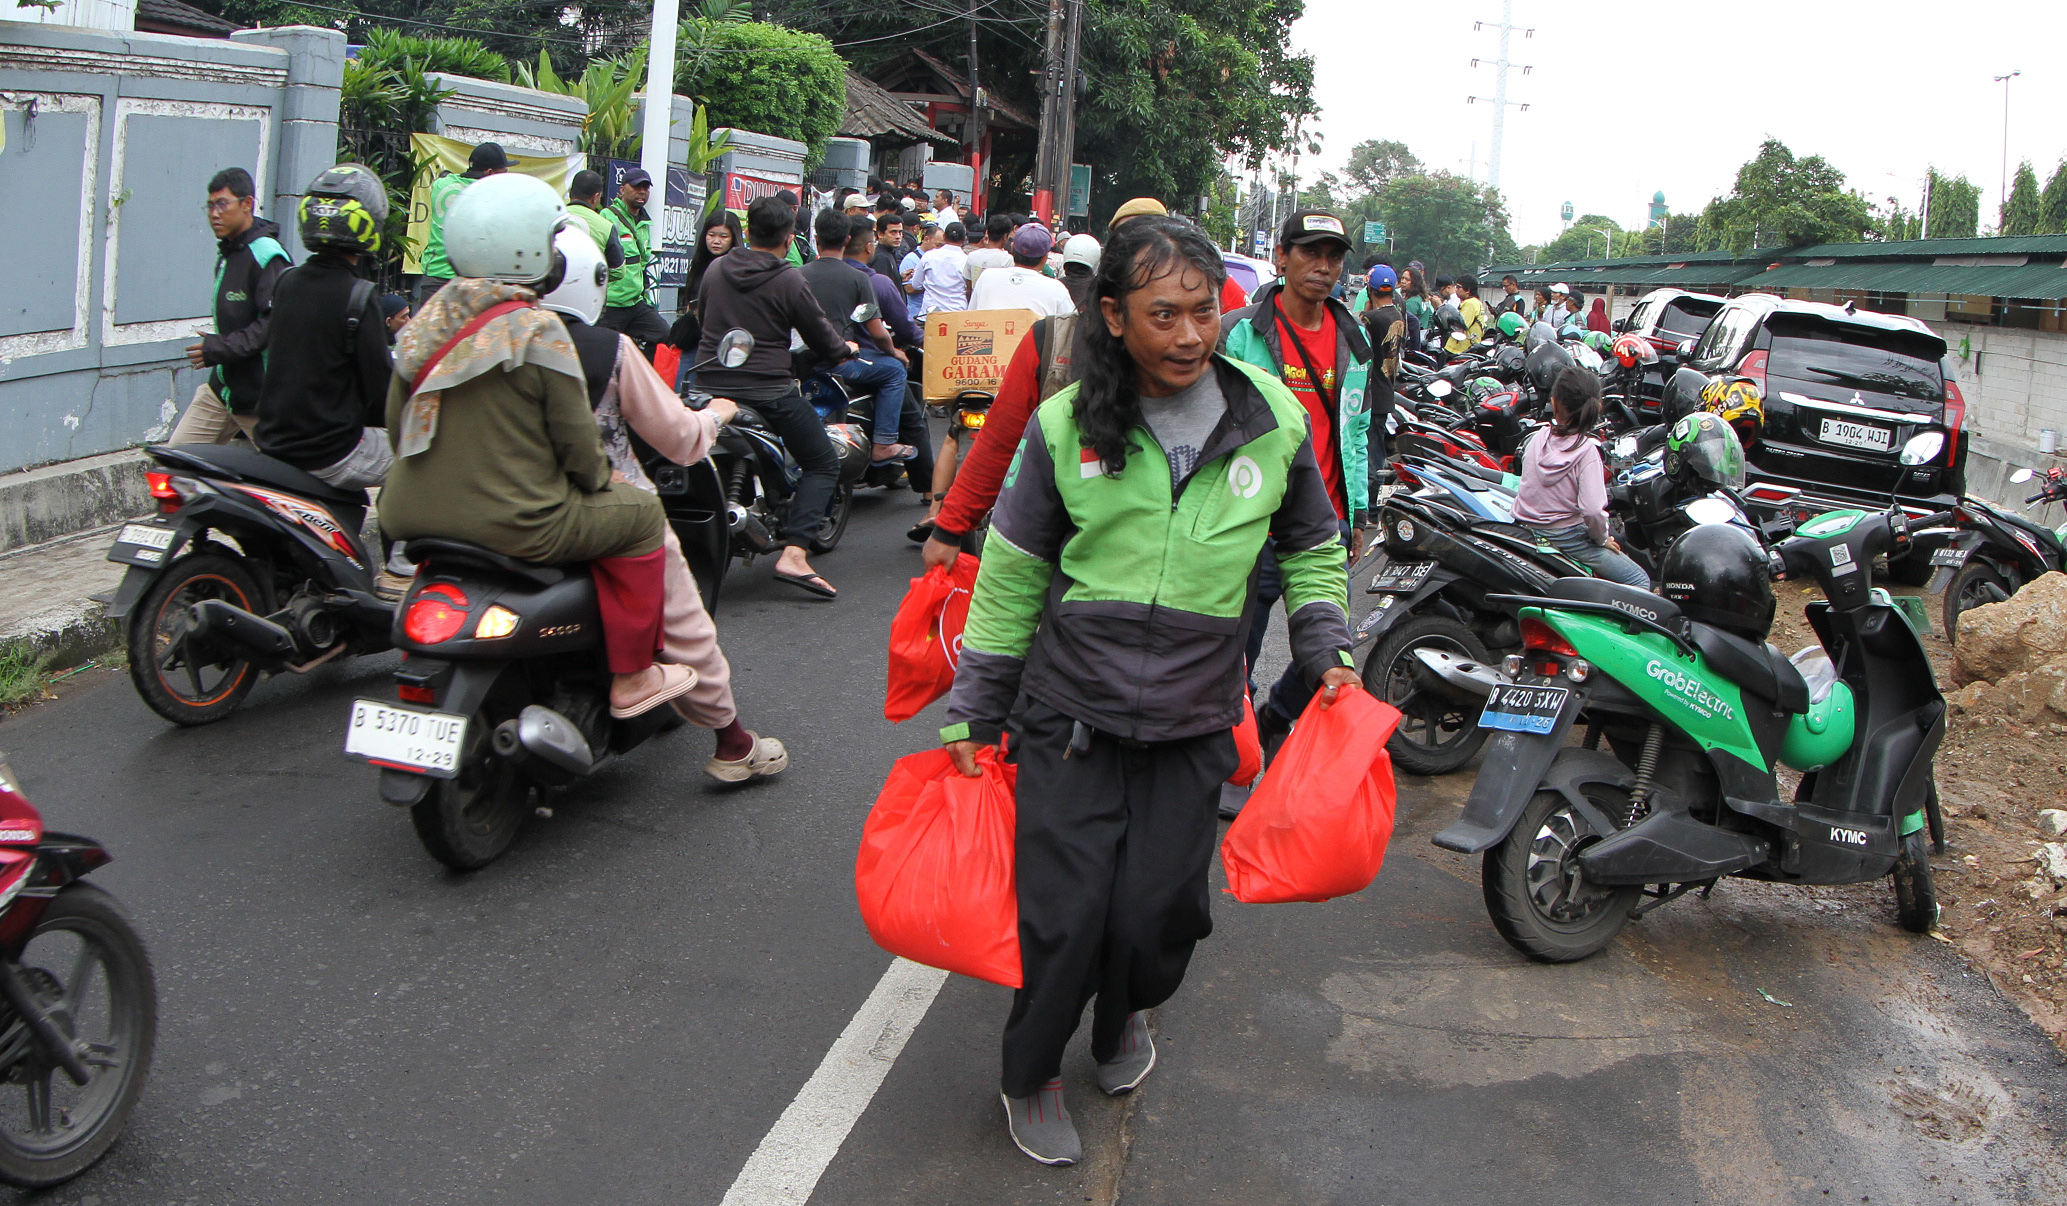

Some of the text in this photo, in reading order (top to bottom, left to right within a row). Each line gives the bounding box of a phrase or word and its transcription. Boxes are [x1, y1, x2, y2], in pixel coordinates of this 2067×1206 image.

[951, 355, 998, 365] GUDANG
[942, 365, 1008, 380] GARAM
[1822, 421, 1830, 434] B
[1835, 423, 1863, 439] 1904
[1665, 582, 1696, 591] HONDA
[1611, 599, 1658, 622] KYMCO
[1489, 687, 1564, 710] B 4420 SXW
[1646, 659, 1734, 720] GrabElectric
[1664, 688, 1684, 704] Powered
[1689, 703, 1712, 719] KYMCO
[354, 707, 460, 743] B 5370 TUE
[0, 829, 35, 841] ONDA
